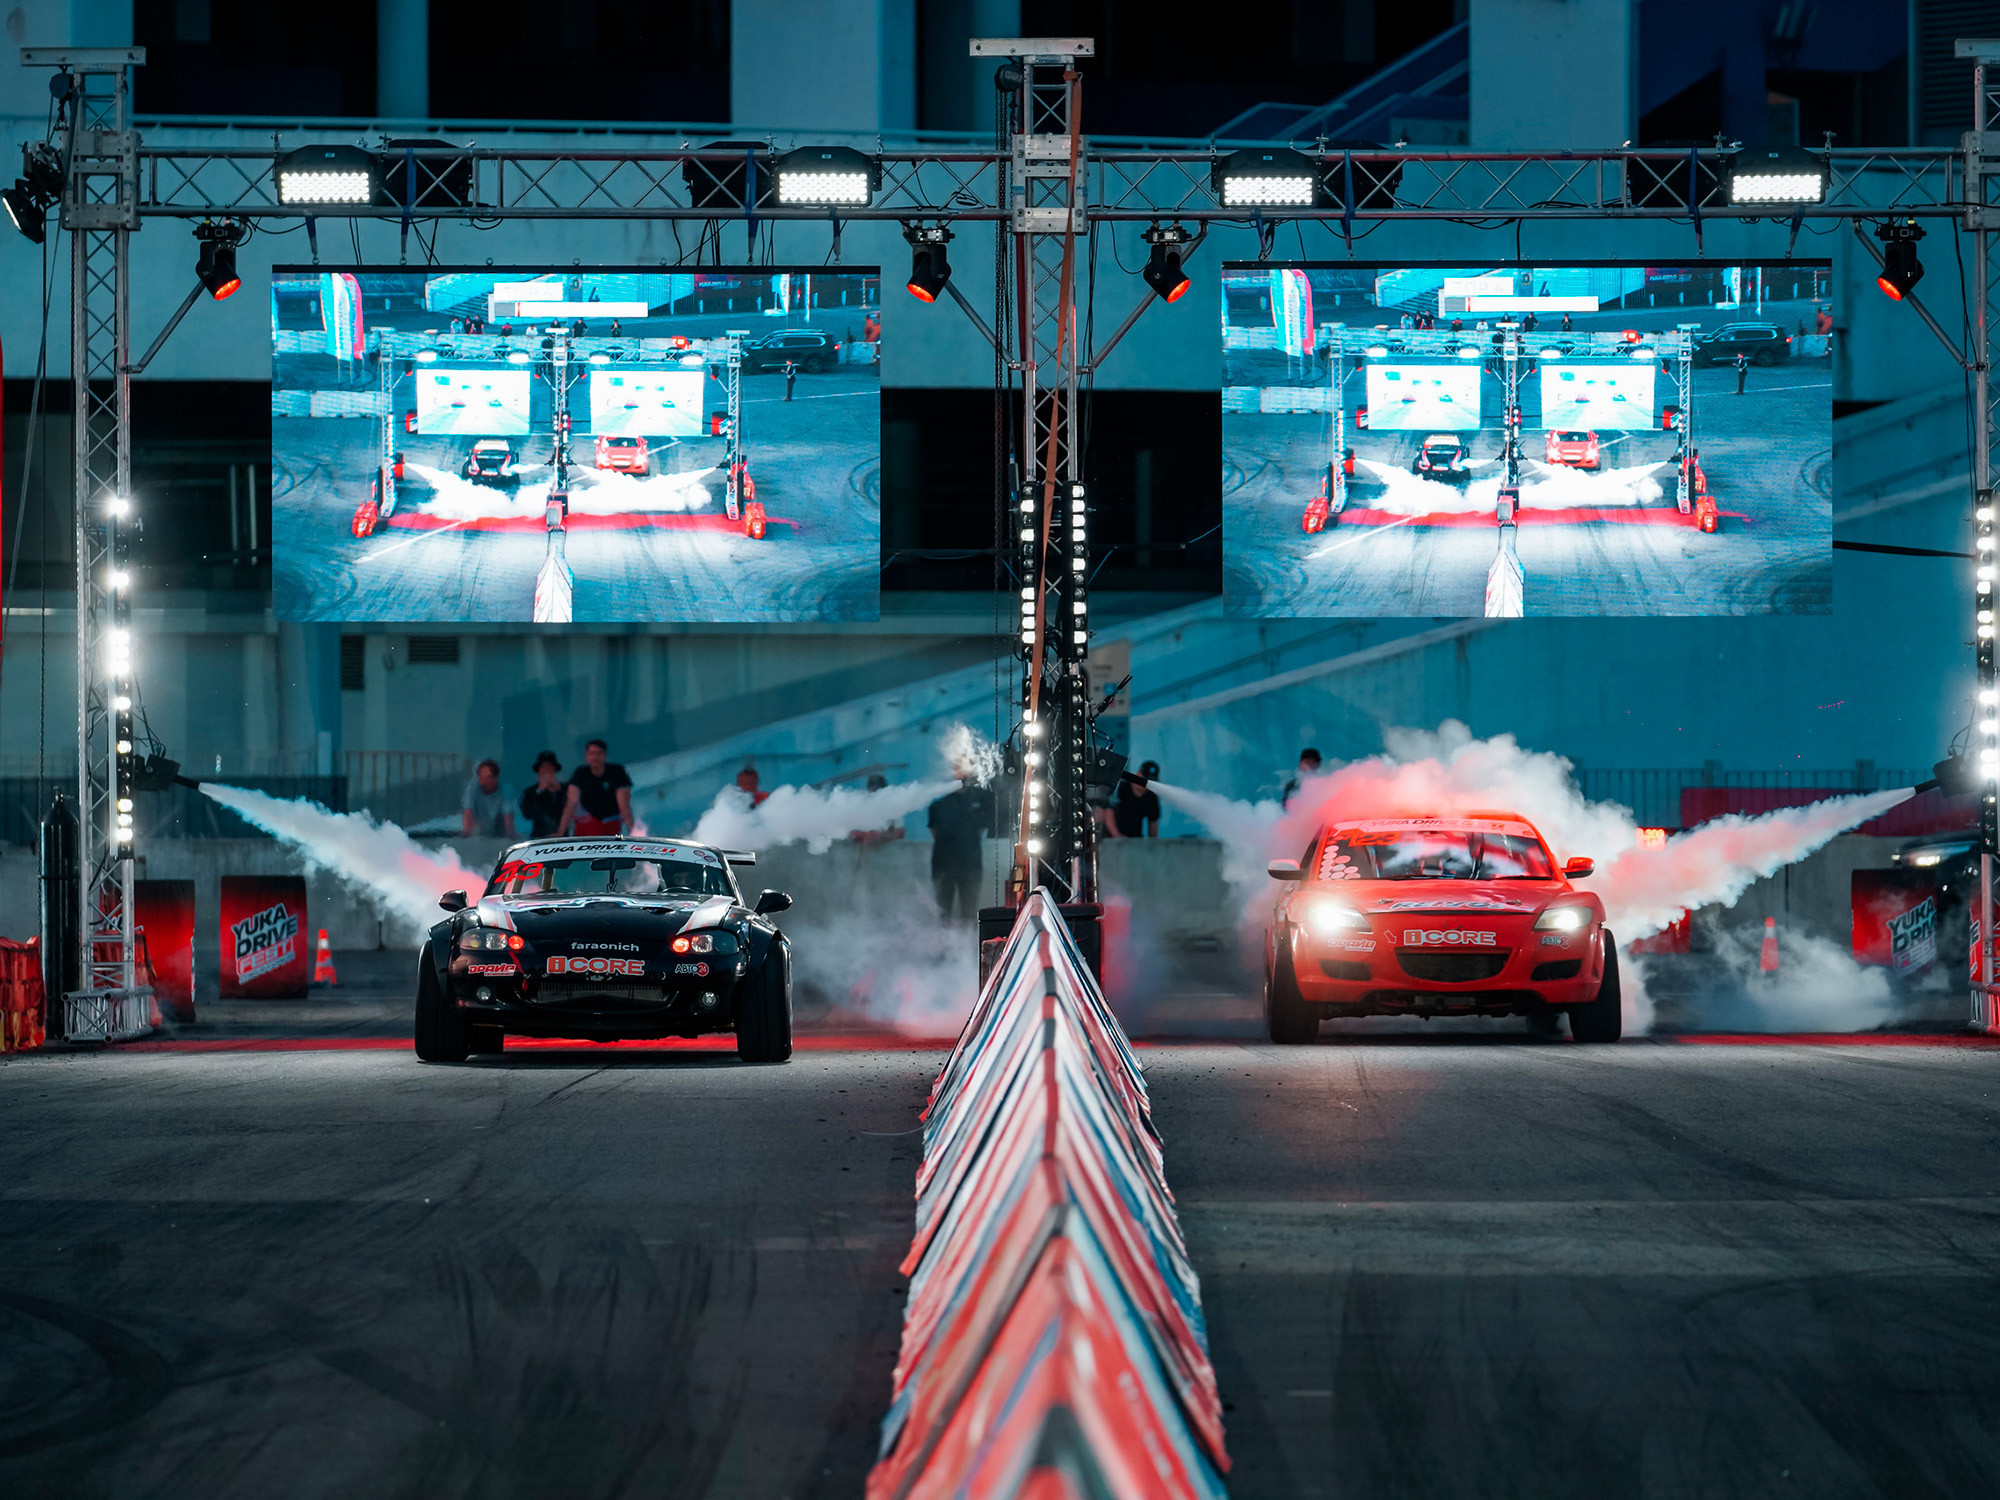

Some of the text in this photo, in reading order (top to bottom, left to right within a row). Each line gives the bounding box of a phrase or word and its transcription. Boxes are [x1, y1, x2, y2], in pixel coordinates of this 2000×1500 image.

[504, 286, 538, 296] TOP
[1454, 282, 1489, 291] TOP
[535, 846, 575, 856] YUKA
[493, 863, 544, 884] 43
[231, 904, 287, 940] YUKA
[1886, 896, 1934, 938] YUKA
[237, 915, 298, 958] DRIVE
[571, 942, 640, 951] faraonich
[239, 939, 292, 974] FEST
